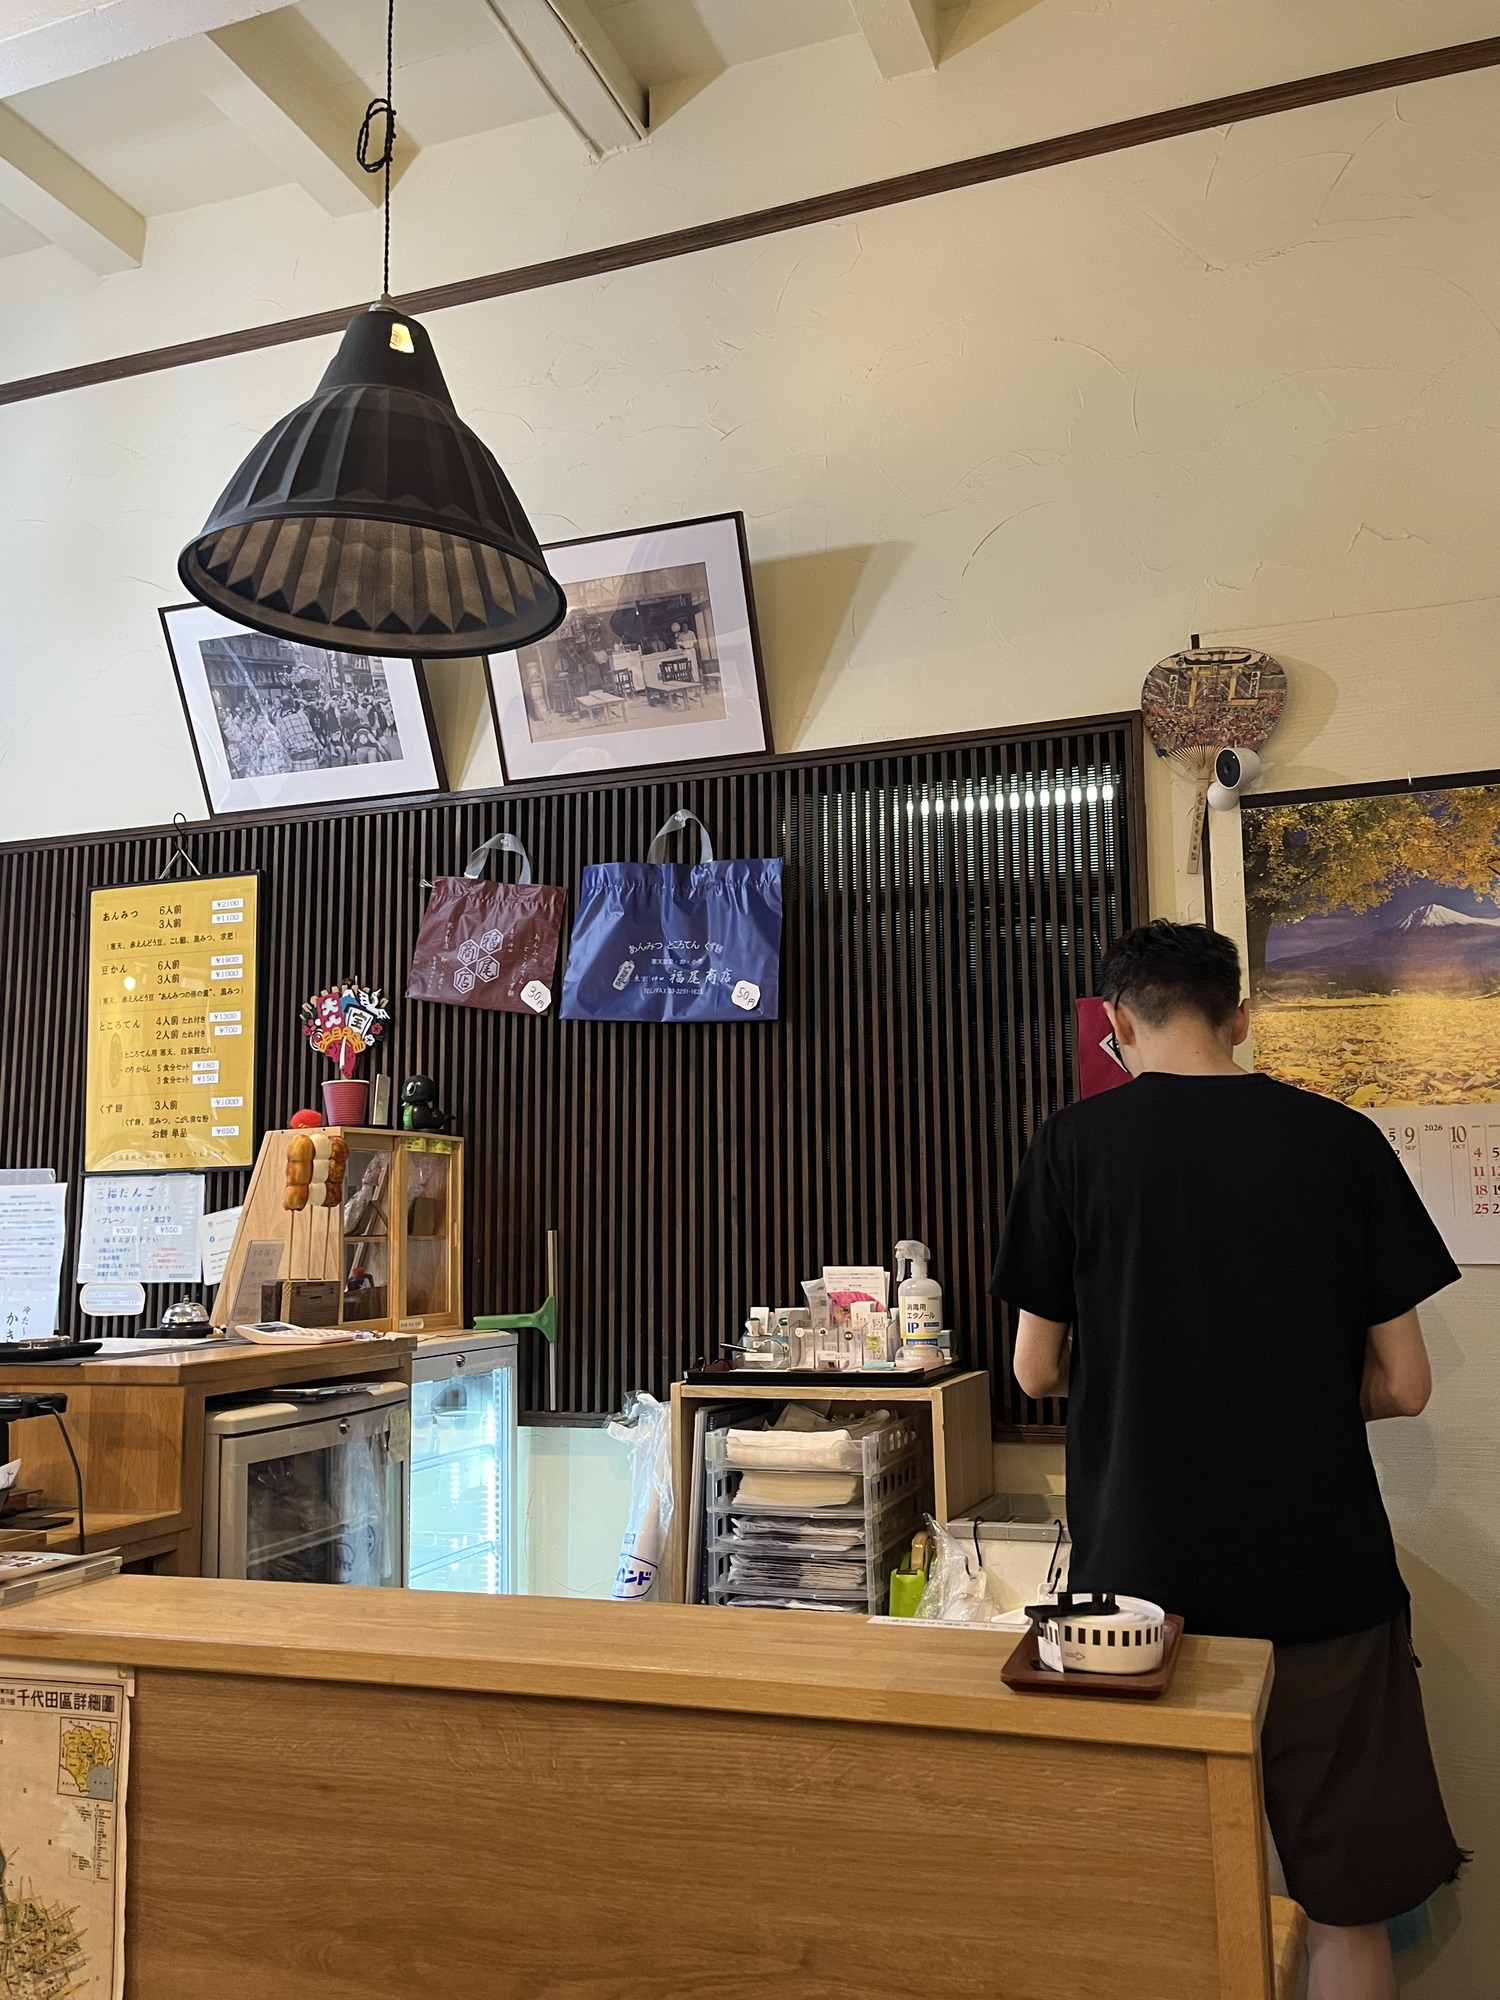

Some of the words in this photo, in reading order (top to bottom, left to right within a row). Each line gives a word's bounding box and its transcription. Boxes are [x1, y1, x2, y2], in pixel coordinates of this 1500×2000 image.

[217, 900, 240, 908] ¥2100
[103, 910, 139, 921] あんみつ
[159, 904, 182, 915] 6人前
[216, 914, 239, 922] ¥1100
[159, 919, 181, 929] 3人前
[628, 941, 663, 954] あんみつ
[666, 940, 700, 950] ところてん
[704, 941, 724, 954] くず餅
[216, 956, 239, 964] ¥1900
[101, 964, 128, 975] 豆かん
[157, 960, 180, 970] 6人前
[157, 974, 180, 984] 3人前
[216, 970, 239, 978] ¥1000
[669, 967, 733, 985] 福尾商店
[527, 986, 545, 1009] 30円
[737, 987, 756, 1006] 50円
[100, 1019, 141, 1031] ところてん
[156, 1015, 179, 1026] 4人前
[182, 1016, 206, 1025] たれ付き
[156, 1030, 179, 1040] 2人前
[181, 1030, 206, 1038] たれ付き
[99, 1104, 123, 1114] くず餅
[154, 1100, 178, 1110] 3人前
[215, 1098, 239, 1106] ¥1000
[1404, 1127, 1415, 1144] 9
[1450, 1125, 1467, 1143] 10
[1473, 1147, 1482, 1157] 4
[1492, 1147, 1500, 1158] 5
[1473, 1166, 1485, 1177] 11
[1475, 1184, 1488, 1195] 18
[1474, 1203, 1489, 1214] 25
[1492, 1204, 1500, 1214] 2
[102, 1217, 126, 1225] プレーン
[160, 1226, 178, 1234] ¥550
[906, 1303, 927, 1311] 消毒用
[907, 1312, 935, 1320] エタノール
[907, 1322, 920, 1333] IP
[17, 1689, 115, 1712] 千代田區詳細圖
